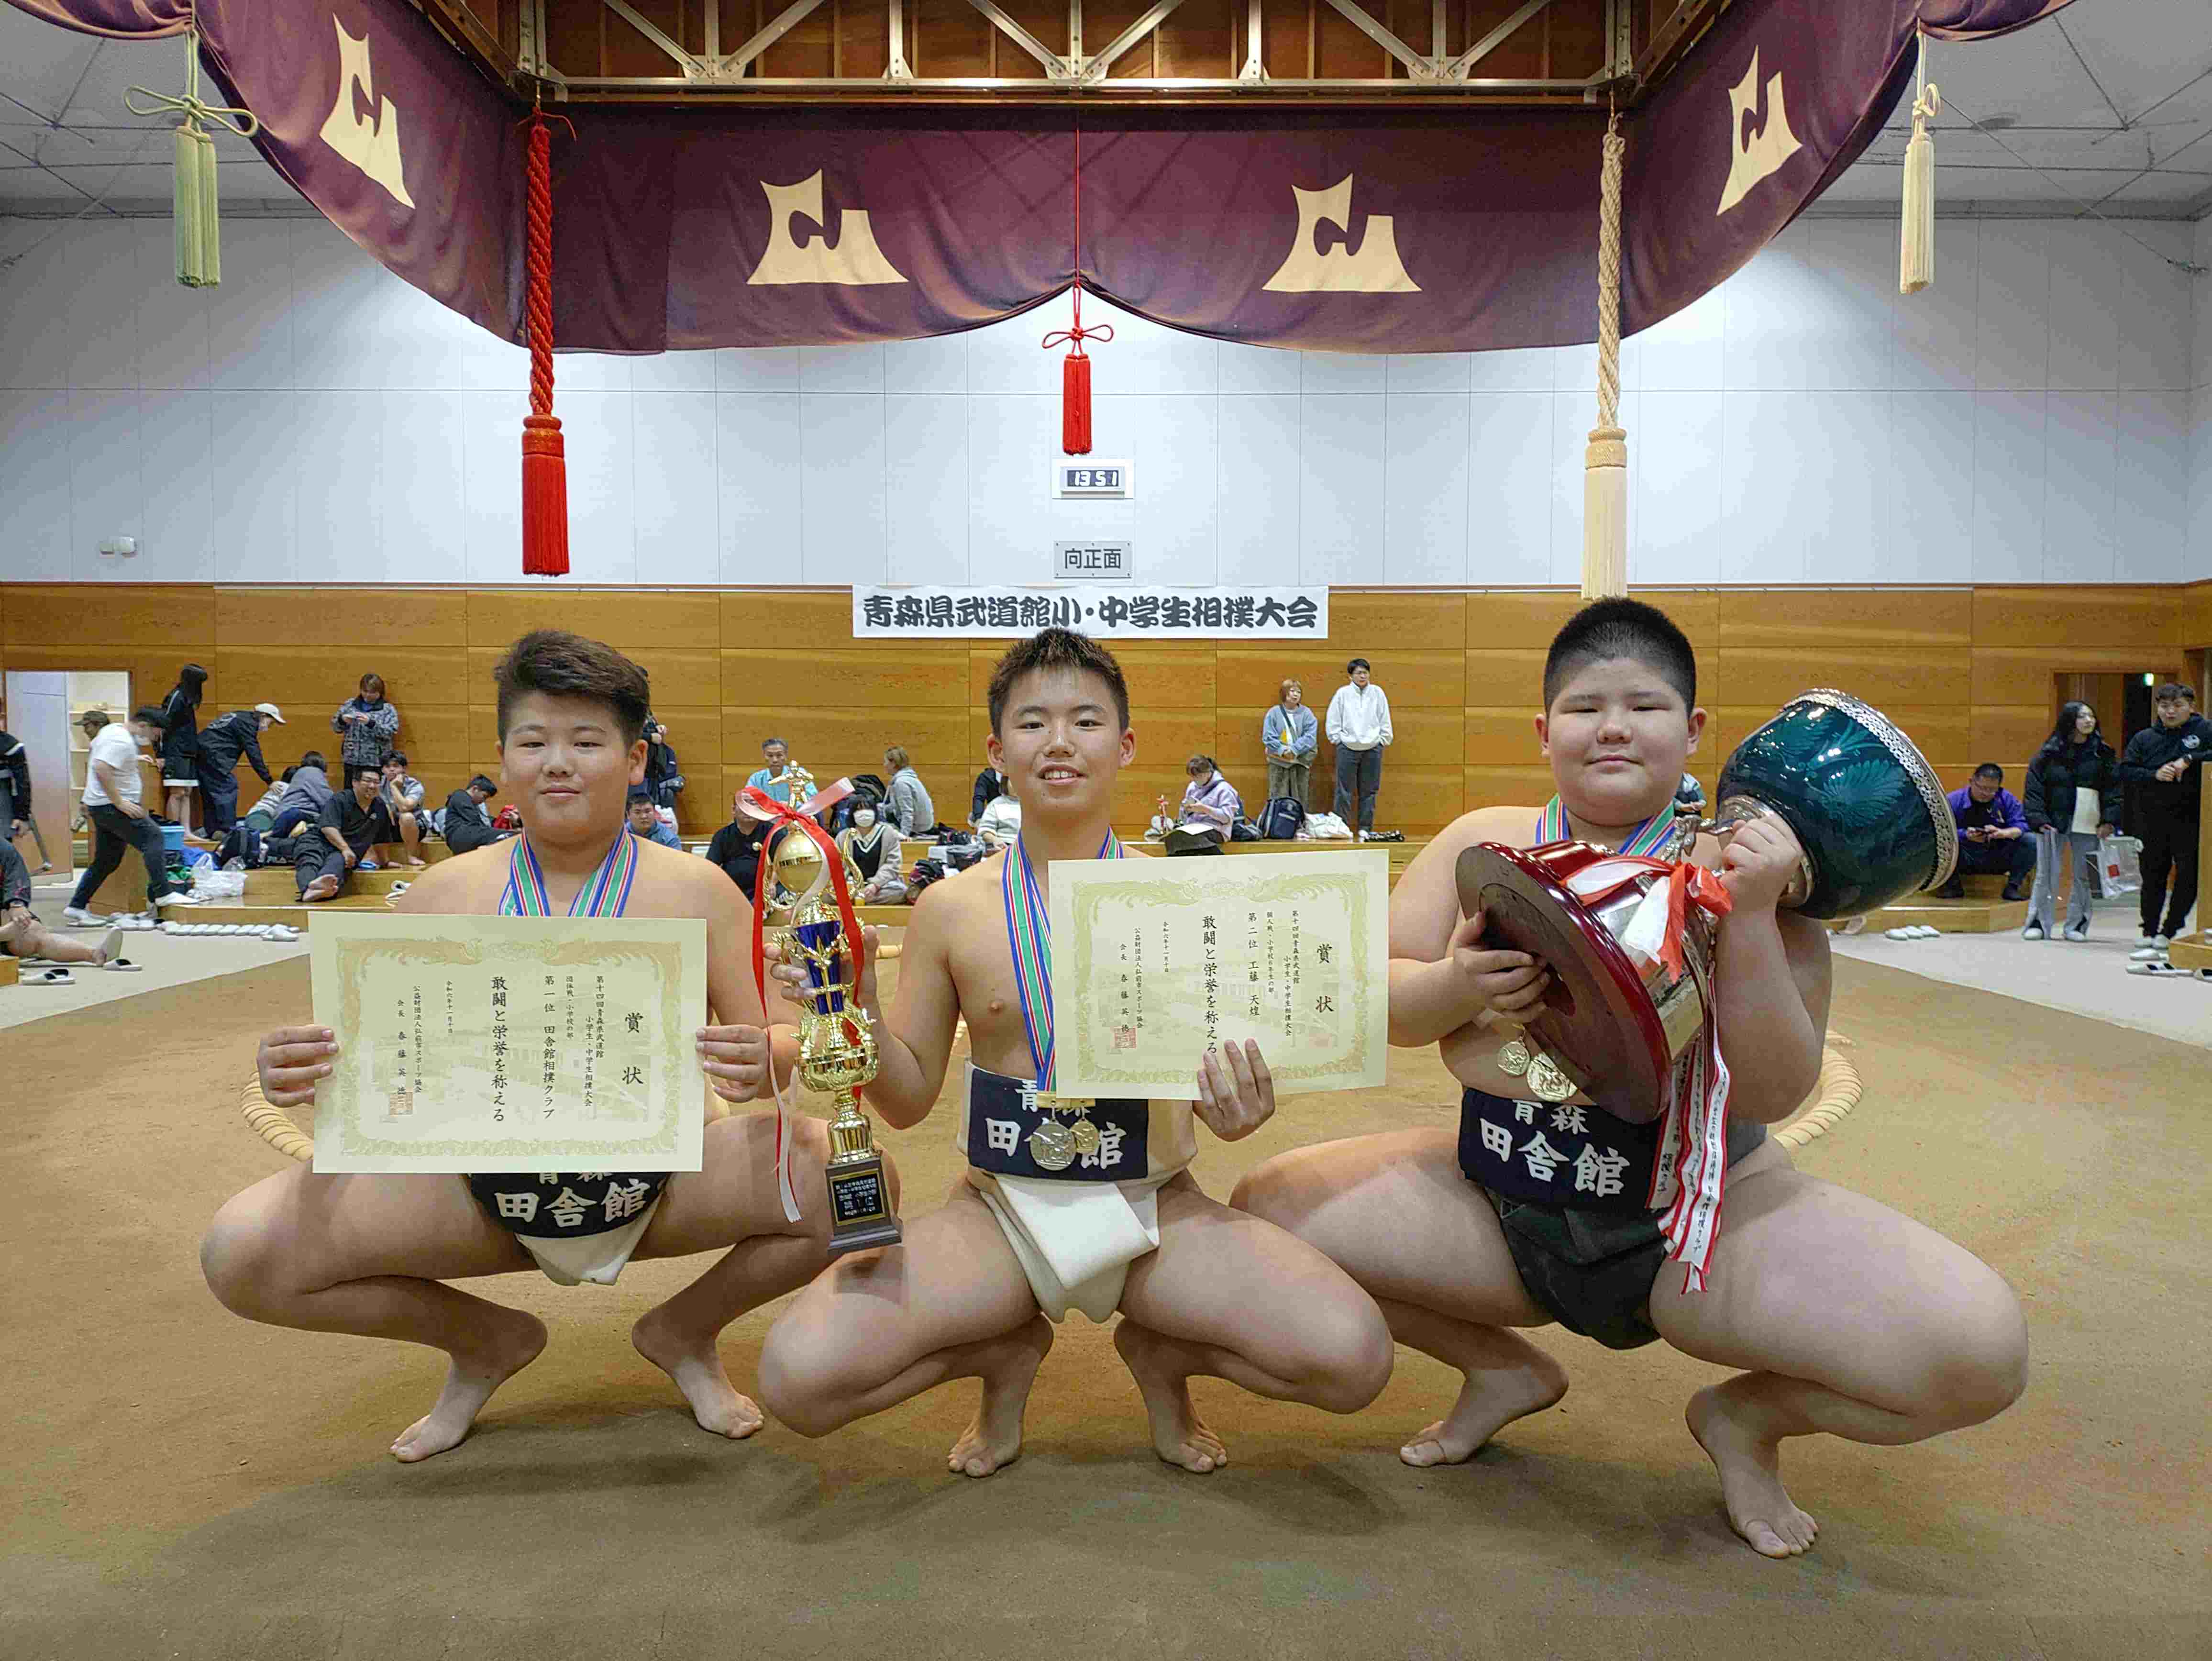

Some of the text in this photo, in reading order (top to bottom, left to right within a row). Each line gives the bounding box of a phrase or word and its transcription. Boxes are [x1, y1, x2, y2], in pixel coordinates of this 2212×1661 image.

[1065, 548, 1121, 569] 向正面
[863, 595, 1317, 627] 青森県武道館小・中学生相撲大会
[1248, 913, 1258, 948] 第二位
[1203, 916, 1218, 1053] 敢闘と栄誉を称える
[1249, 961, 1259, 982] 工藤
[491, 976, 509, 1121] 敢闘と栄誉を称える
[543, 976, 556, 1118] 第一位 田舎館相撲クラブ
[985, 1118, 1127, 1170] 田館
[1480, 1118, 1630, 1197] 田舎館
[494, 1178, 651, 1228] 田舎館
